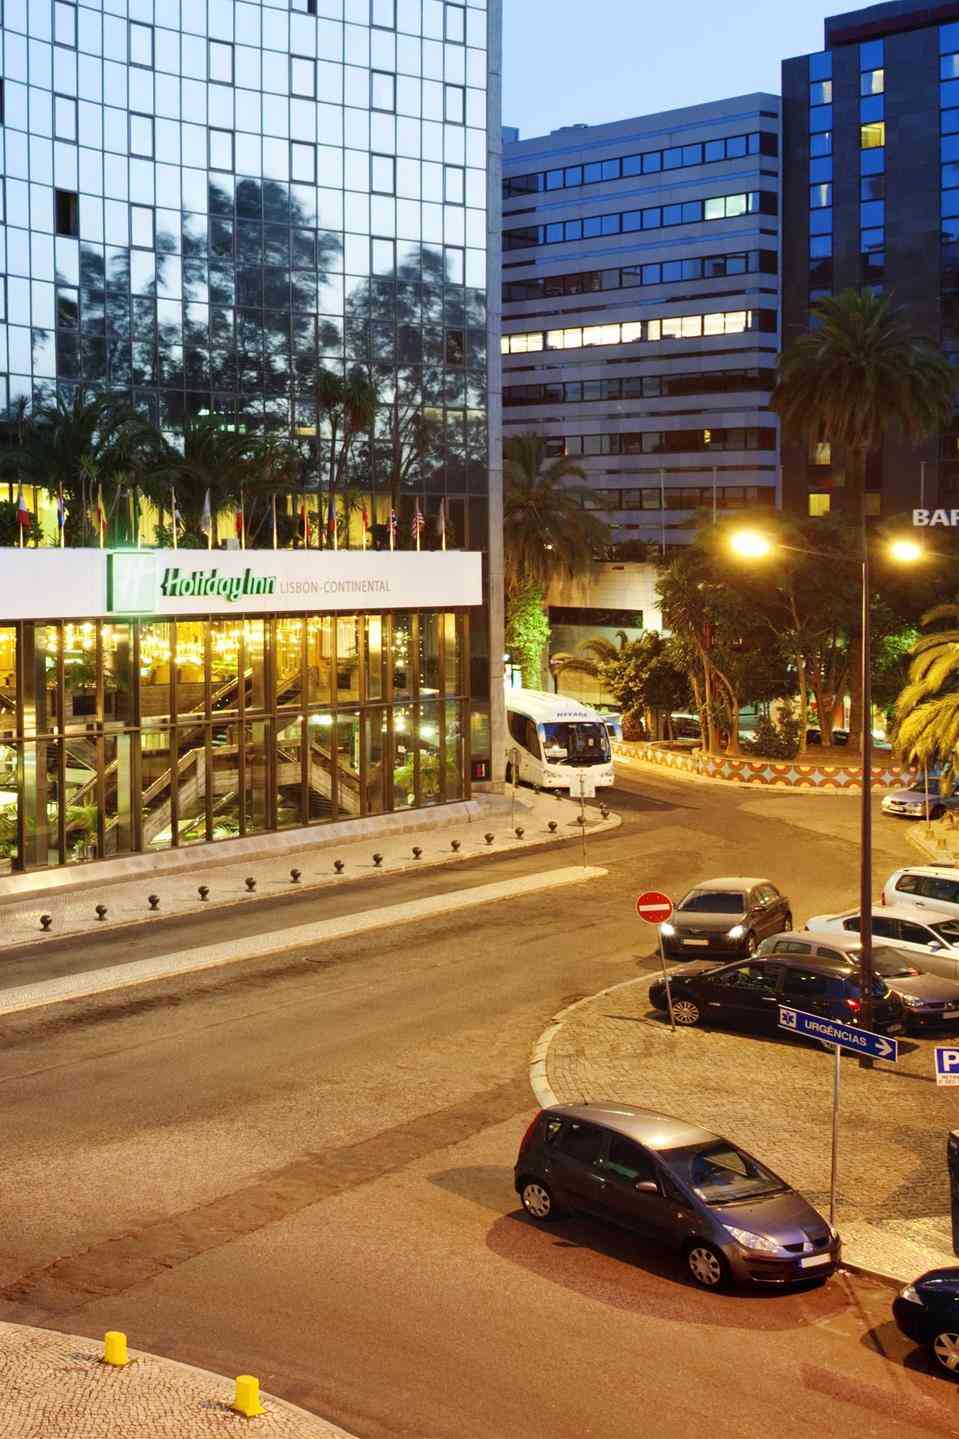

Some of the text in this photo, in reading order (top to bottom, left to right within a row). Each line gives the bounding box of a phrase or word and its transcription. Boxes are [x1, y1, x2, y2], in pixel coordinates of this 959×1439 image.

[161, 568, 241, 602] Holiday
[242, 568, 277, 594] Inn
[804, 1020, 867, 1046] URGÊNCIAS
[943, 1050, 959, 1072] P
